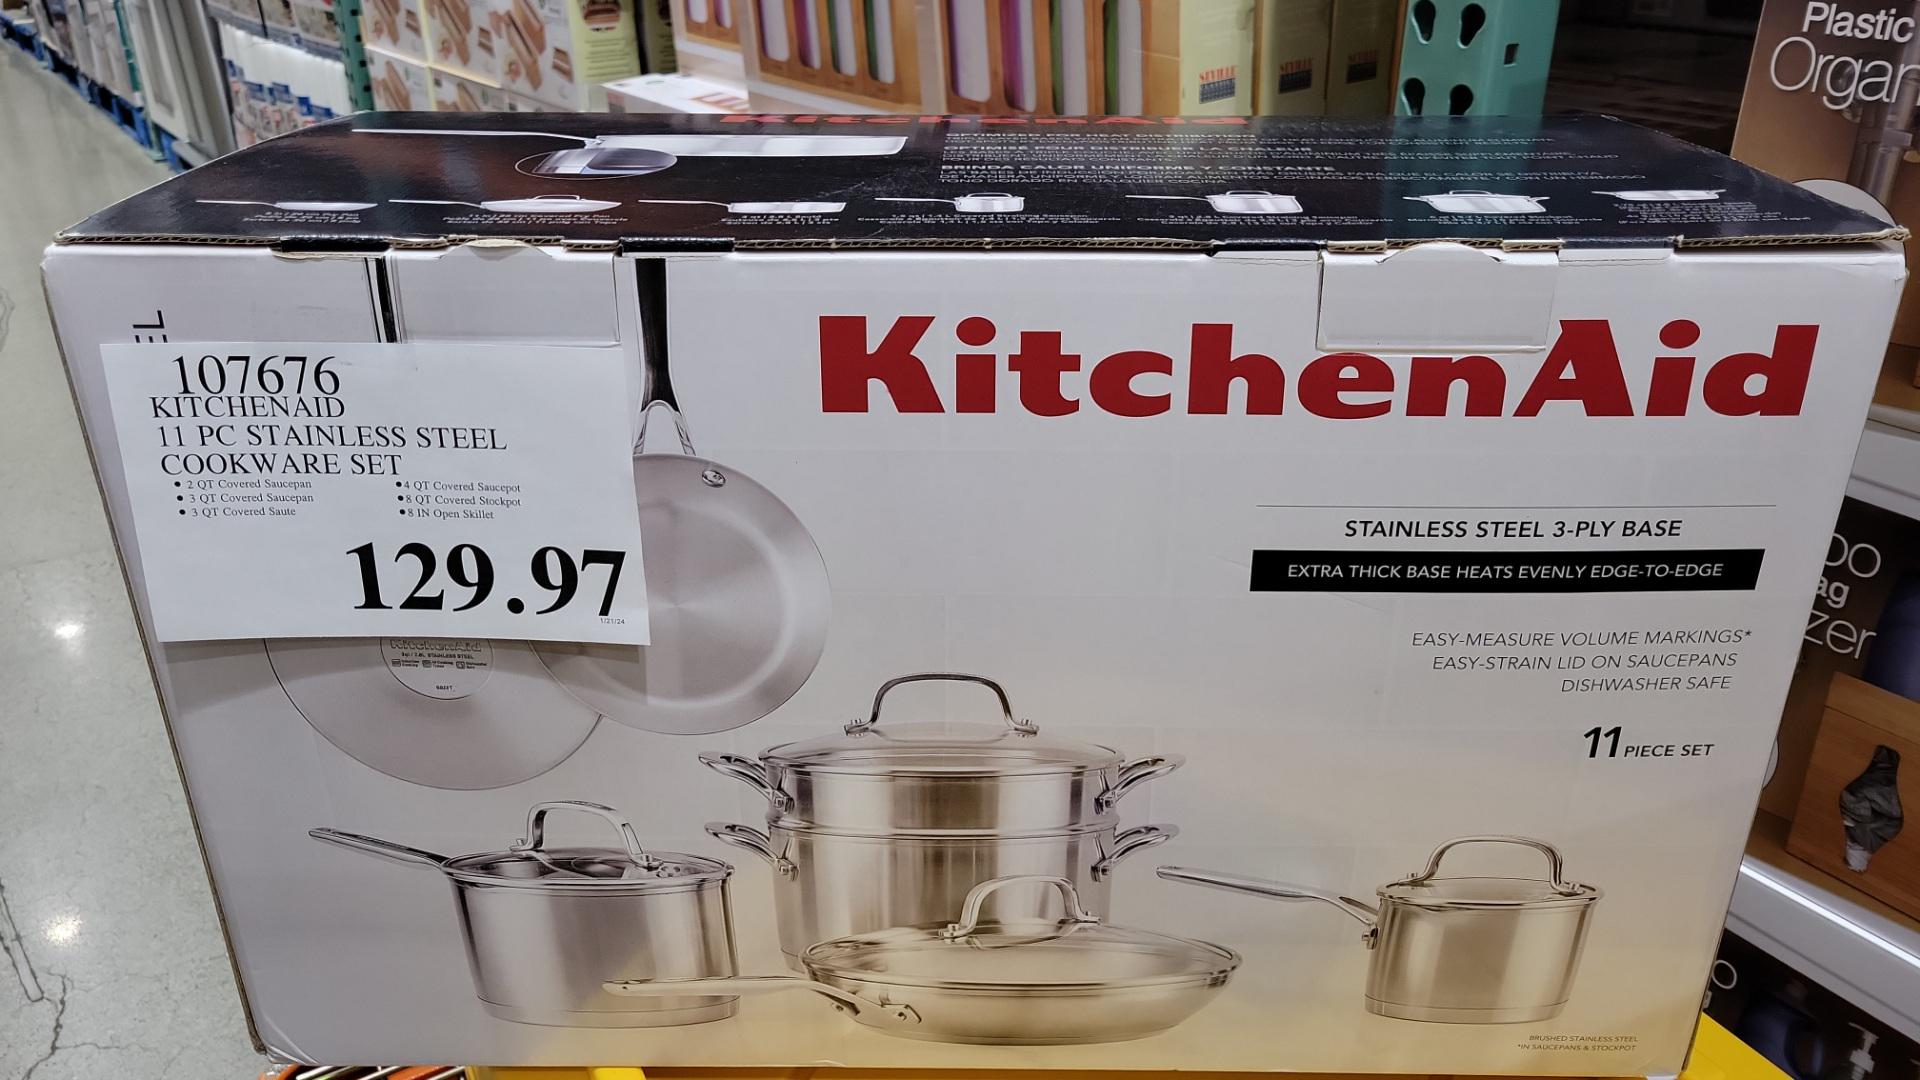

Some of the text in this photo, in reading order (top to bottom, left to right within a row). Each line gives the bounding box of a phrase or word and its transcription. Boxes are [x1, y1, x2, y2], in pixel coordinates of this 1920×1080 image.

[1802, 1, 1916, 43] Plastic
[172, 355, 340, 396] 107676
[819, 316, 1819, 420] KitchenAid
[150, 396, 344, 417] KITCHENAID
[160, 425, 507, 449] 11 PC STAINLESS STEEL
[161, 453, 401, 475] COOKWARE SET
[187, 479, 312, 491] 2 QT Covered Saucepan
[404, 481, 521, 495] 4 QT Covered Saucepot
[190, 493, 314, 505] 3 QT Covered Saucepan
[406, 495, 521, 509] 8 QT Covered Stockpot
[192, 507, 296, 519] 3 QT Covered Saute
[408, 508, 494, 521] 8 IN Open Skillet
[1345, 520, 1682, 537] STAINLESS STEEL 3-PLY BASE
[346, 542, 626, 616] 129.97
[1289, 564, 1723, 579] EXTRA THICK BASE HEATS EVENLY EDGE-TO-EDGE
[1413, 633, 1554, 646] EASY-MEASURE
[1561, 632, 1639, 646] VOLUME
[1433, 653, 1737, 670] EASY-STRAIN LID ON SAUCEPANS
[1562, 676, 1731, 692] DISHWASHER SAFE
[1584, 727, 1715, 758] 11 PIECE SET
[1529, 1035, 1639, 1043] BRUSHED STAINLESS STEEL
